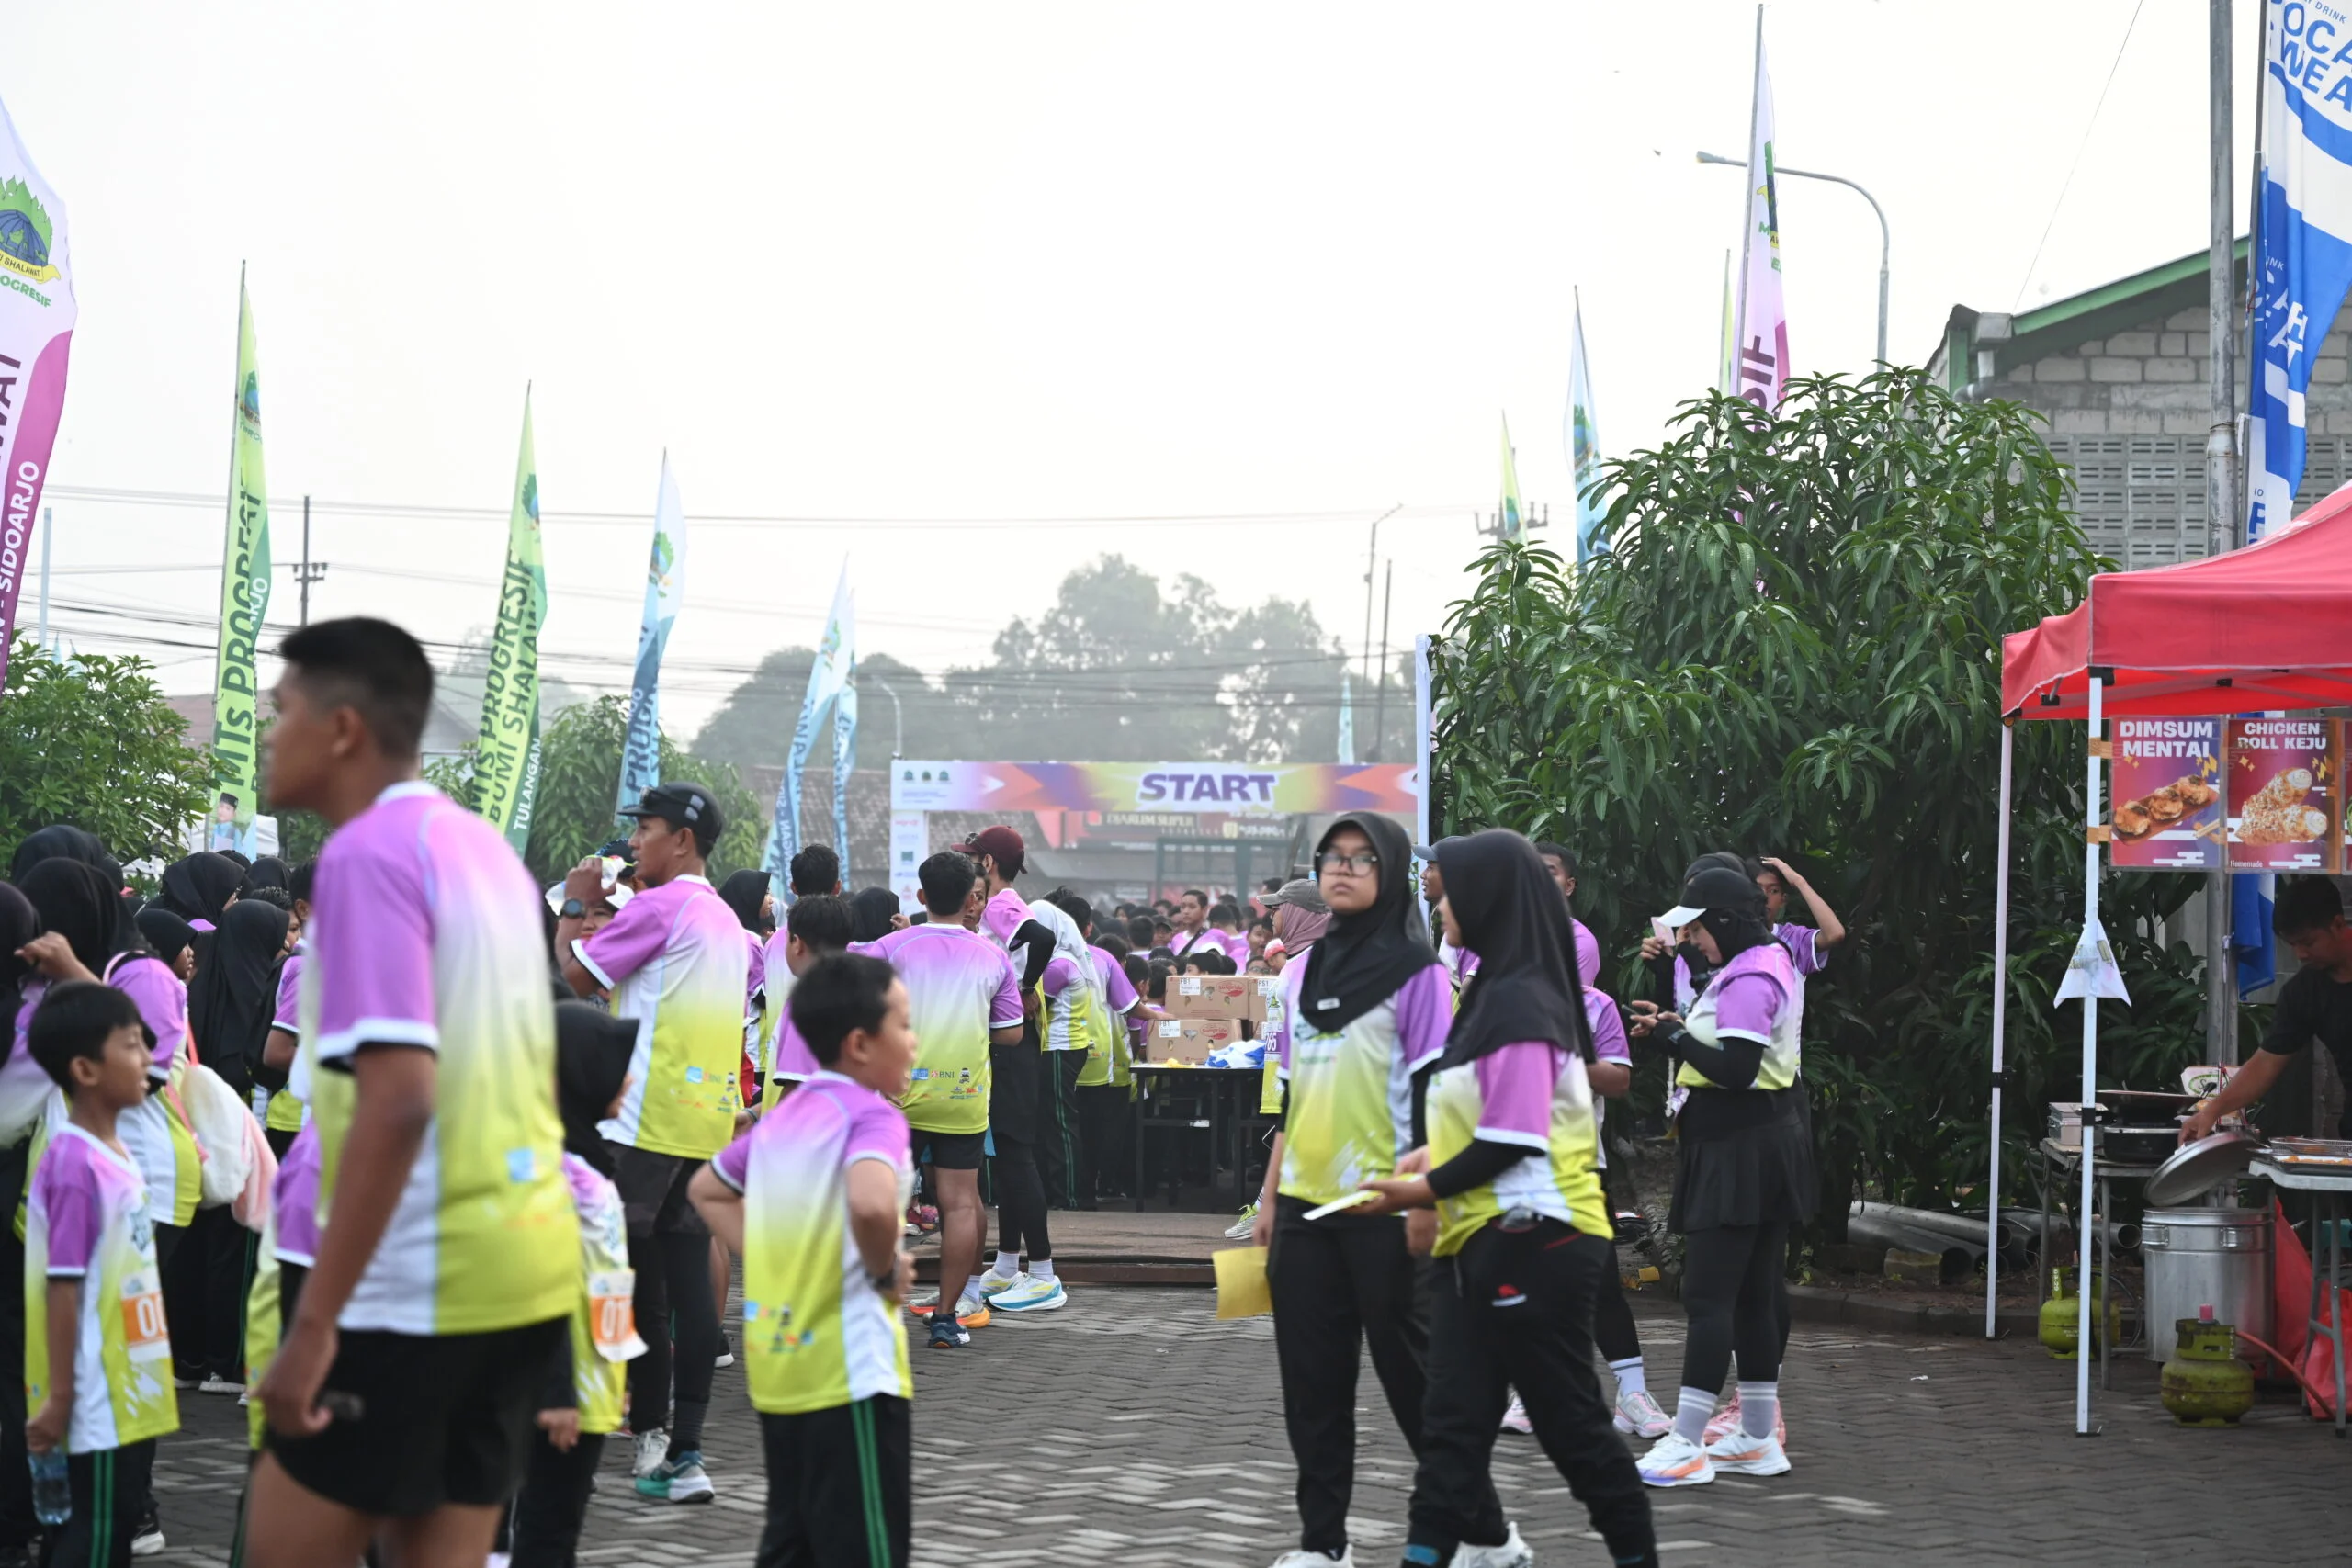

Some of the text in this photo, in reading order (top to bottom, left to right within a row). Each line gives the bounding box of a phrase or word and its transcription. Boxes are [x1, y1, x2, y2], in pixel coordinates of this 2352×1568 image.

[2314, 1, 2347, 25] DRINK
[0, 460, 40, 593] SIDOARJO
[2120, 720, 2213, 739] DIMSUM
[2244, 721, 2321, 735] CHICKEN
[2122, 740, 2210, 758] MENTAI
[2284, 737, 2327, 750] KEJU
[488, 740, 518, 823] BUMI
[513, 738, 541, 830] TULANGAN
[1139, 773, 1276, 802] START
[939, 1071, 955, 1079] BNI
